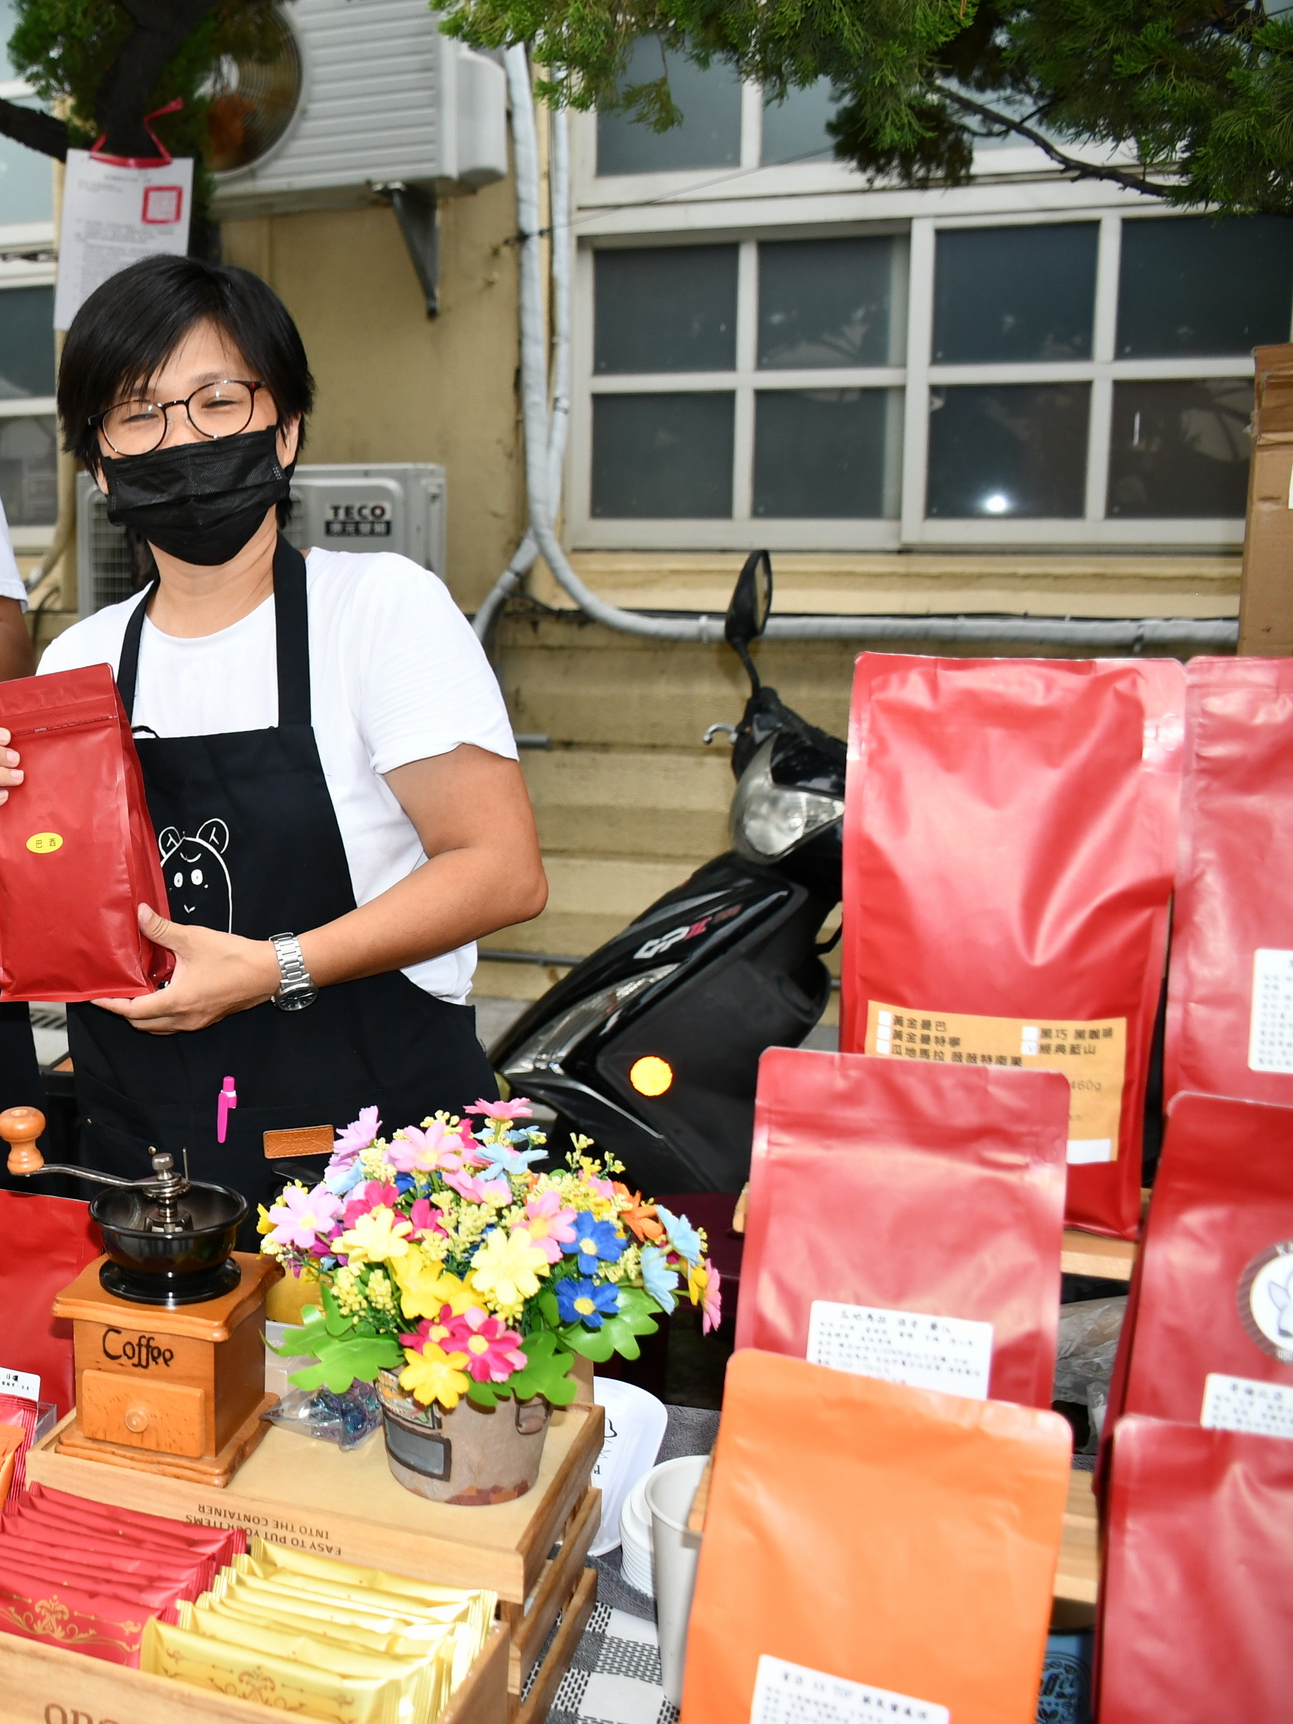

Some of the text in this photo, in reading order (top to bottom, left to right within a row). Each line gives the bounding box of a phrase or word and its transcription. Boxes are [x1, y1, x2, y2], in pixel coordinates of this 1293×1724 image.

[331, 504, 385, 519] TECO
[102, 1328, 175, 1370] Coffee
[198, 1503, 329, 1540] INTO THE CONTAINER
[264, 1532, 287, 1544] PUT
[290, 1537, 306, 1548] TO
[309, 1541, 342, 1556] EASY
